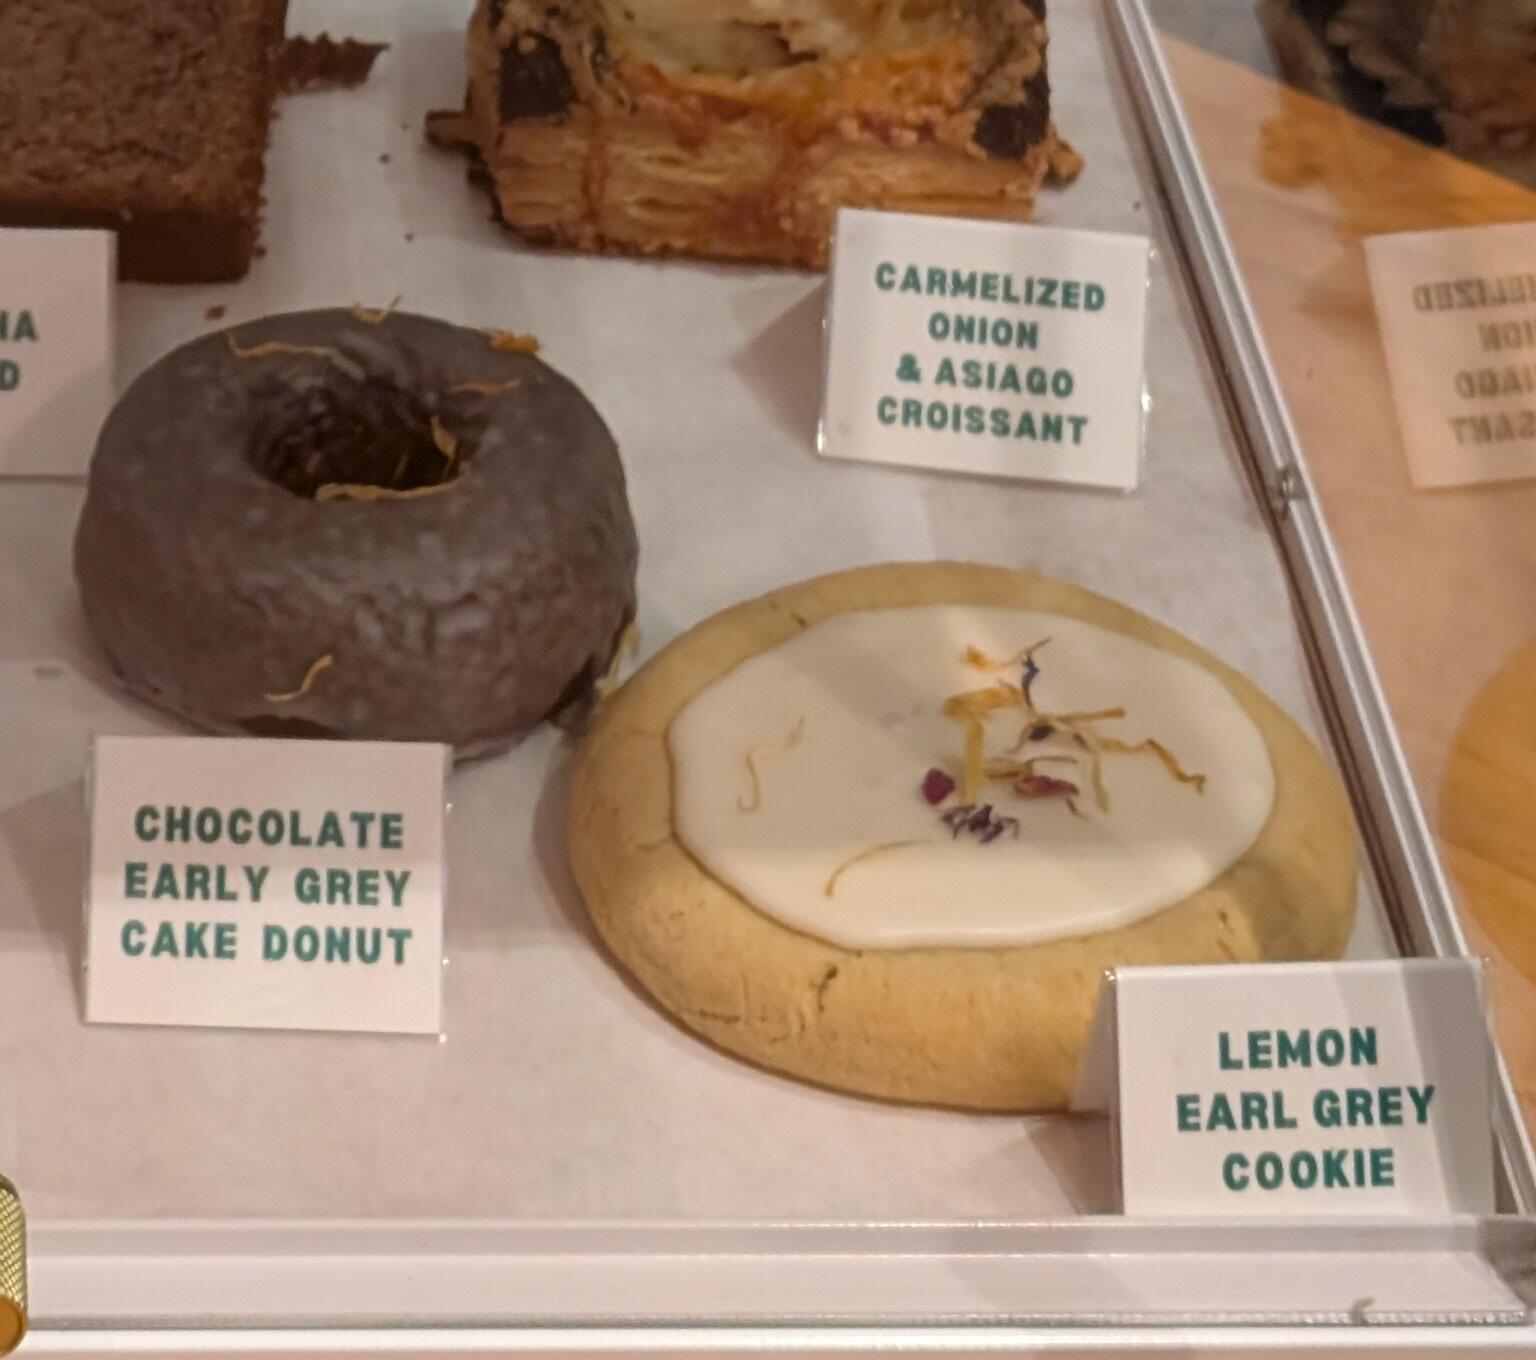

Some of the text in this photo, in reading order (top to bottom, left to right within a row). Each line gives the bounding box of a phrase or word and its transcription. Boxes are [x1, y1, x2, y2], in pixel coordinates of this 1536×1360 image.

[874, 262, 1106, 311] CARMELIZED
[928, 311, 1038, 350] ONION
[896, 353, 1074, 398] & ASIAGO
[877, 396, 1088, 444] CROISSANT
[135, 805, 403, 849] CHOCOLATE
[124, 862, 411, 907] EARLY GREY
[121, 920, 412, 964] CAKE DONUT
[1218, 1027, 1378, 1070] LEMON
[1177, 1085, 1435, 1132] EARL GREY
[1222, 1148, 1395, 1191] COOKIE
